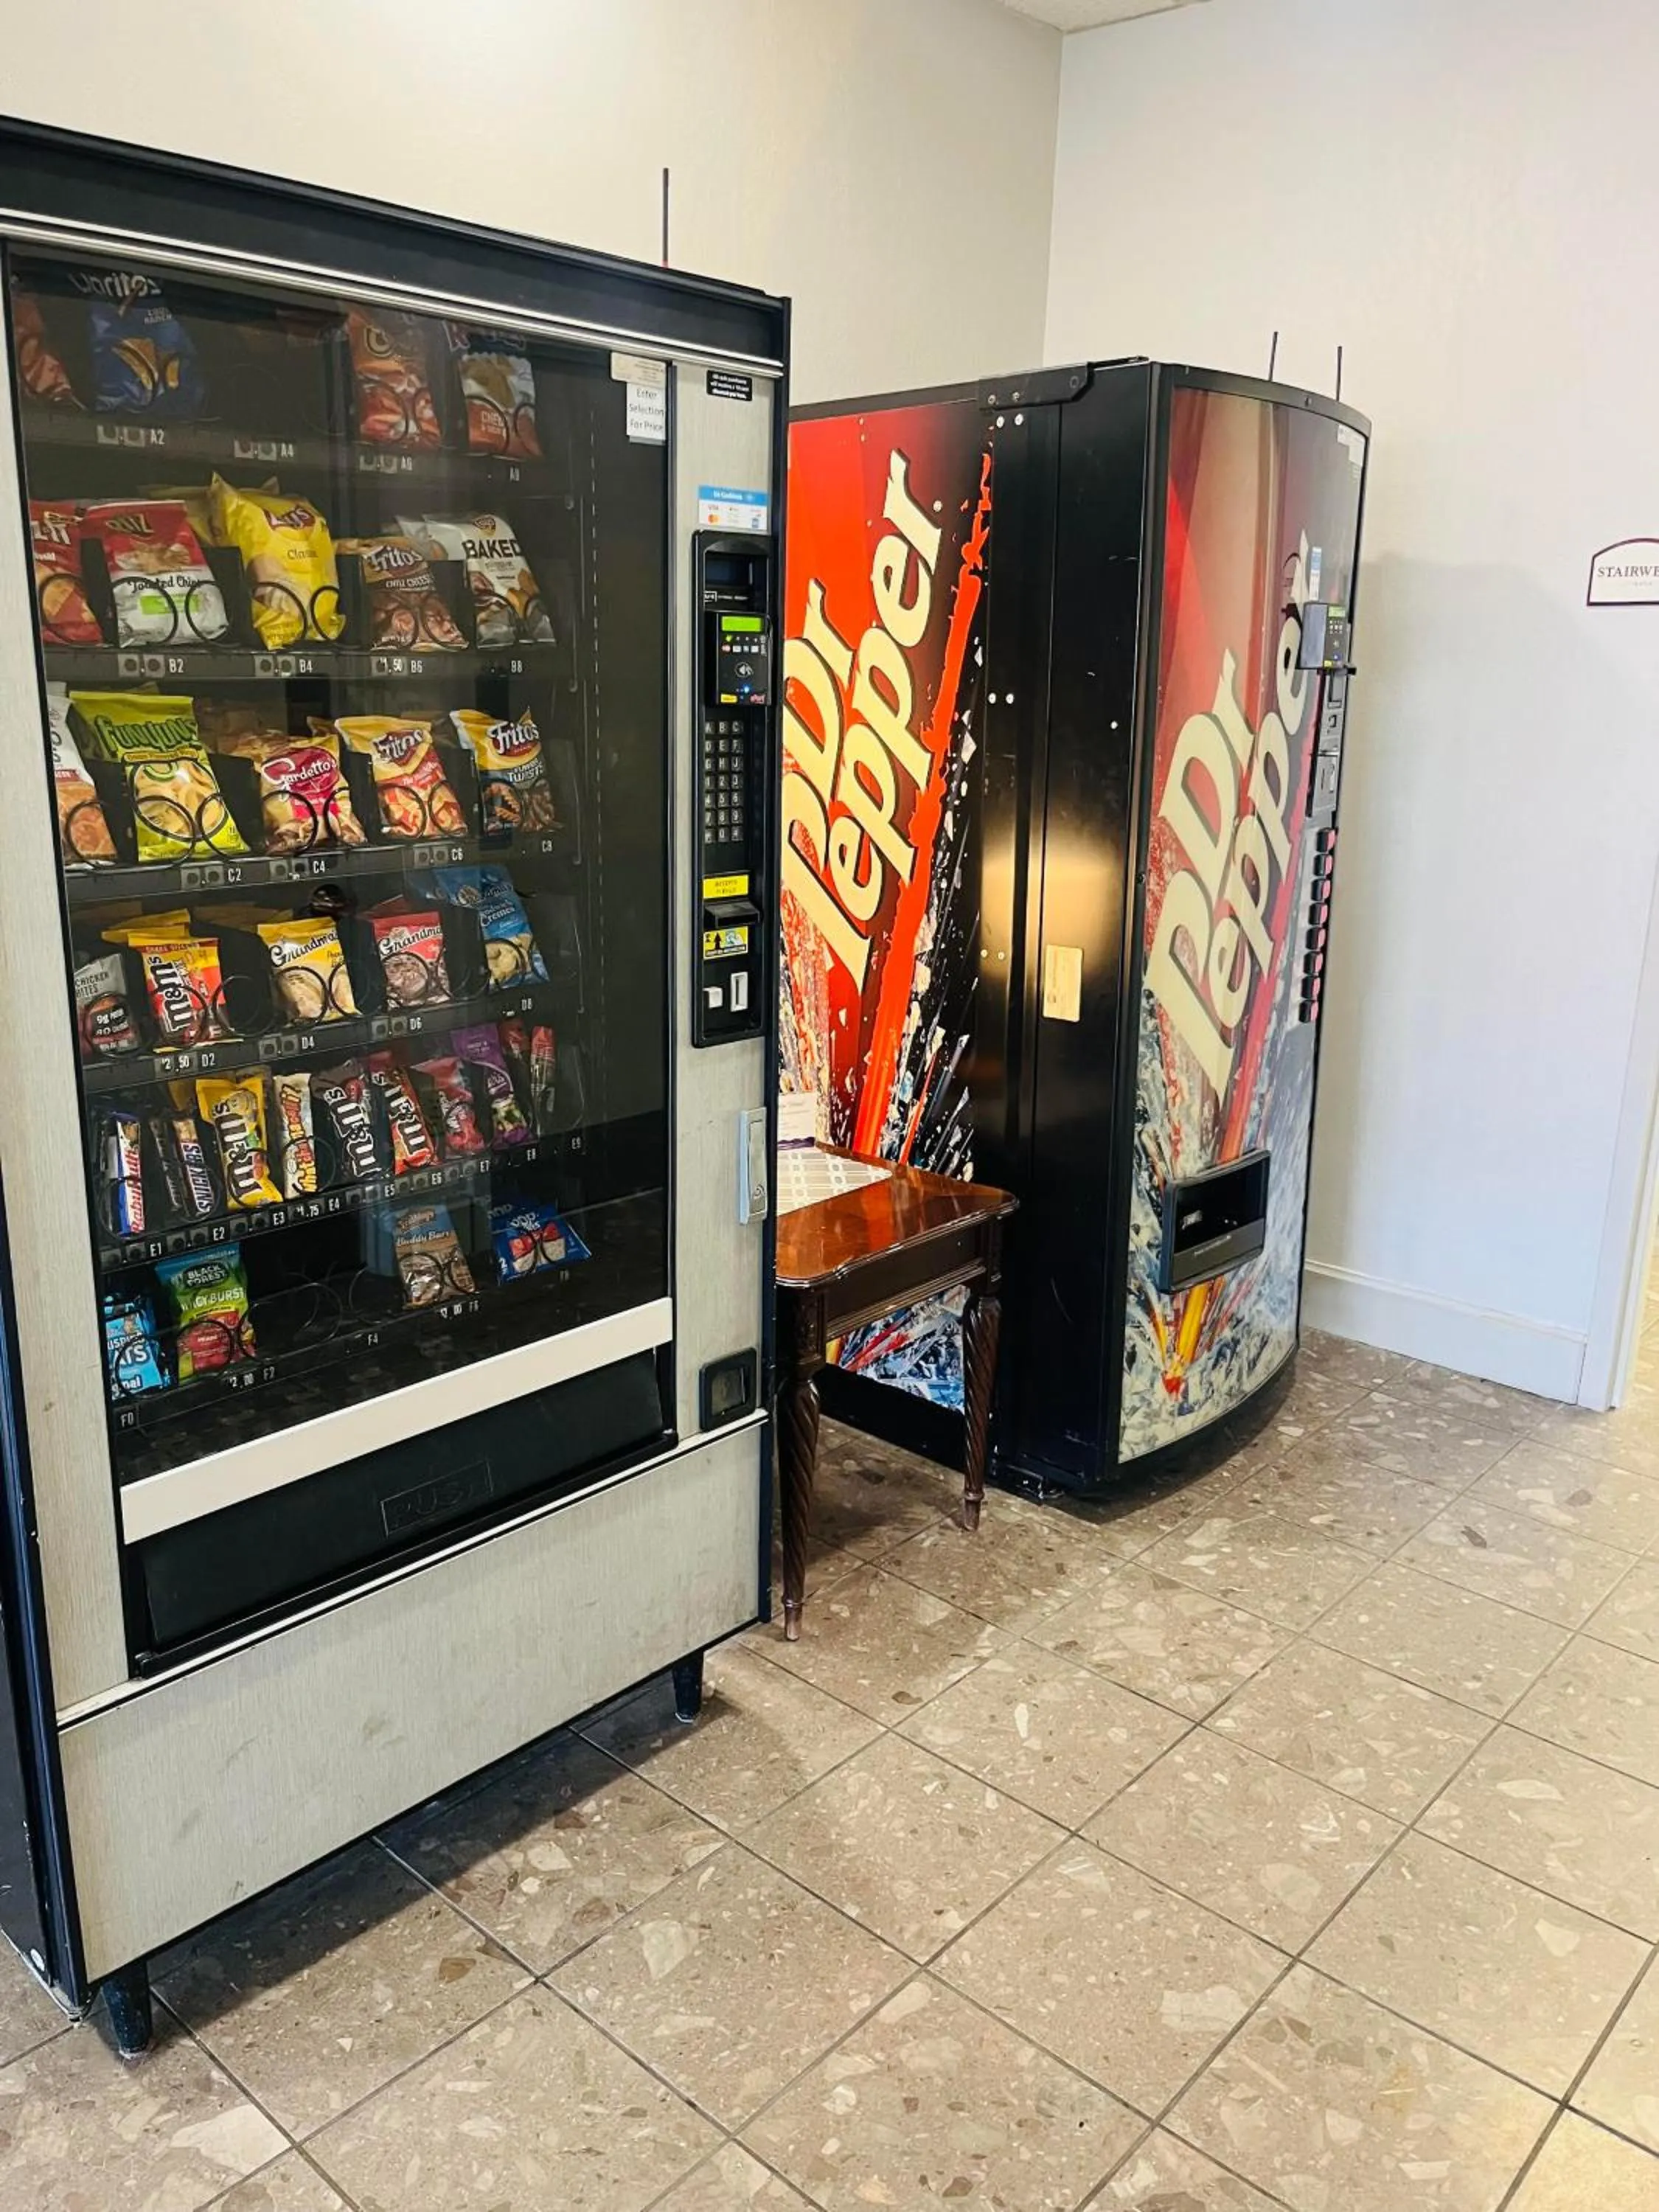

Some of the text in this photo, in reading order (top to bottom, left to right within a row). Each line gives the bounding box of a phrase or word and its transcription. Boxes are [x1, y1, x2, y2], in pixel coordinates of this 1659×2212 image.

[150, 431, 165, 445] A2
[281, 444, 294, 457] A4
[462, 539, 523, 558] BAKED
[169, 659, 184, 673] B2
[299, 658, 313, 672] B4
[411, 660, 422, 673] B6
[487, 721, 540, 754] Fritos
[1158, 647, 1256, 905] Dr
[451, 849, 463, 860] C6
[313, 861, 325, 873] C4
[228, 868, 242, 882] C2
[410, 1018, 422, 1029] D6
[302, 1036, 314, 1049] D4
[202, 1054, 216, 1067] D2
[480, 1161, 490, 1172] E7
[431, 1173, 442, 1185] E6
[385, 1183, 395, 1197] E5
[329, 1197, 340, 1211] E4
[274, 1212, 285, 1225] E3
[214, 1227, 225, 1241] E2
[150, 1242, 162, 1256] E1
[188, 1265, 221, 1279] BLACK
[368, 1334, 378, 1346] F4
